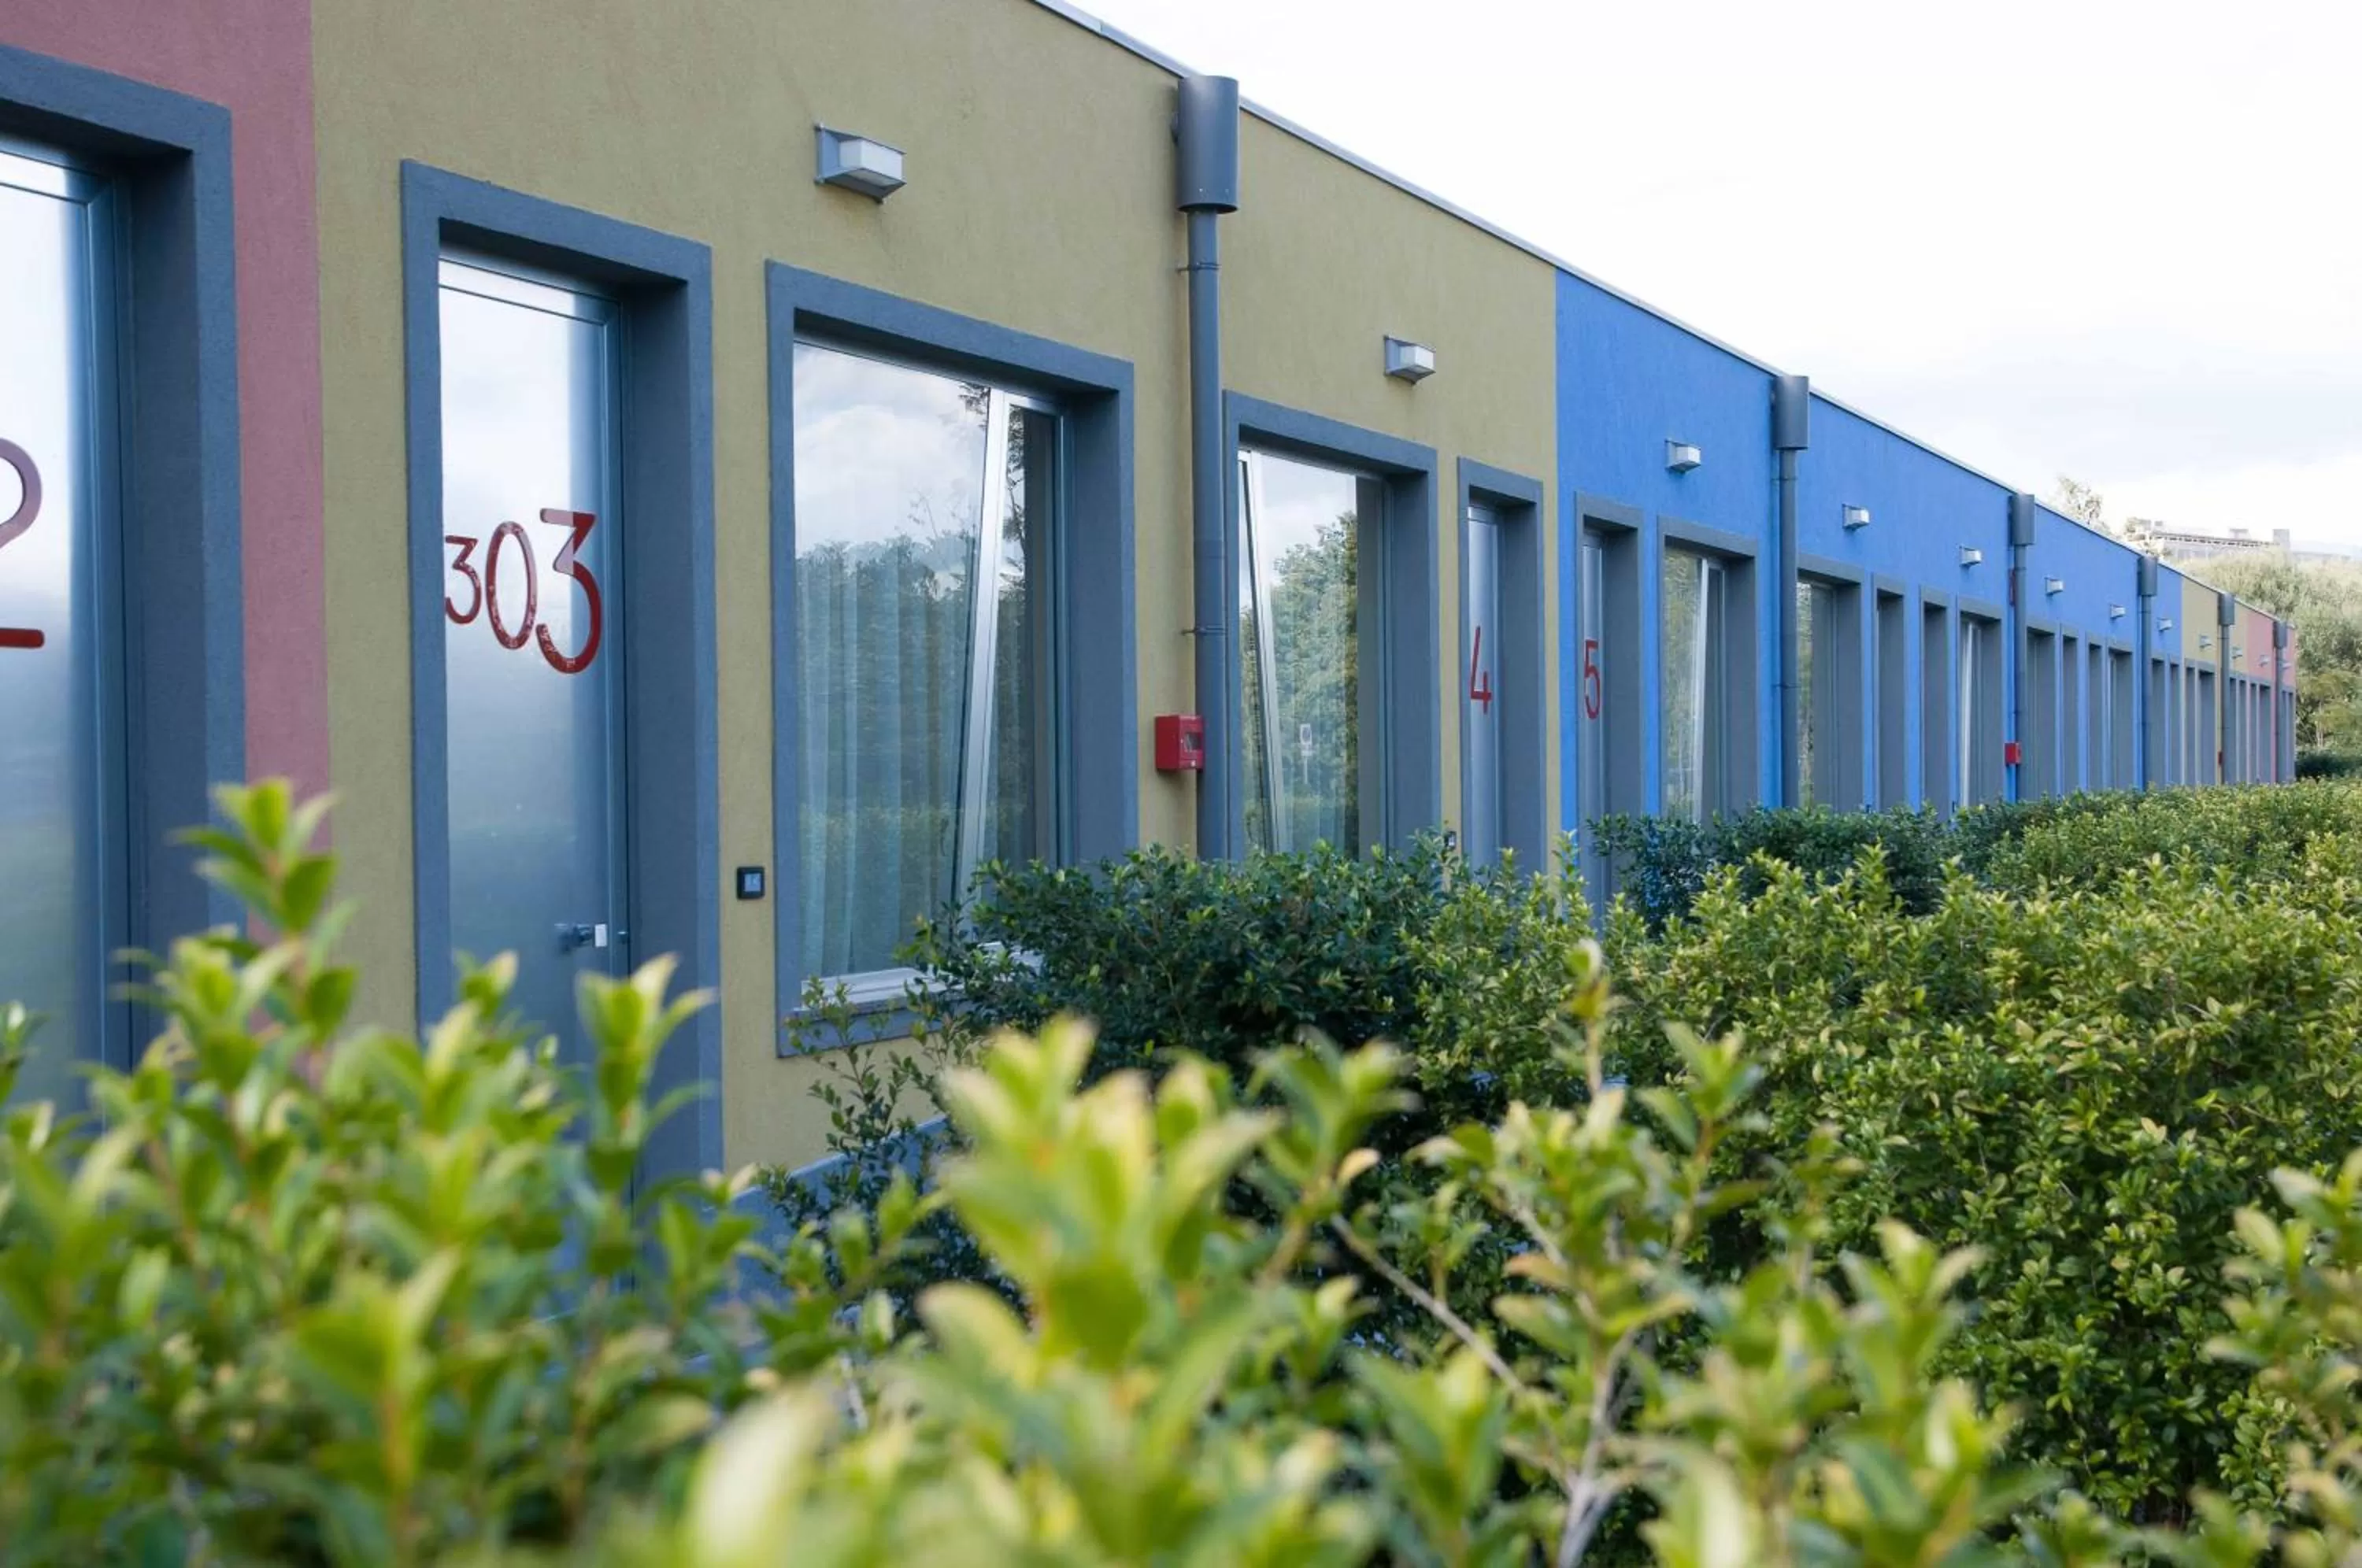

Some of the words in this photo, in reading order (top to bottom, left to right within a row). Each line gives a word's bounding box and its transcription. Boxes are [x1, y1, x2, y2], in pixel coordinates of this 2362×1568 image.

[445, 508, 602, 674] 303
[1470, 626, 1492, 715] 4
[1583, 639, 1601, 719] 5
